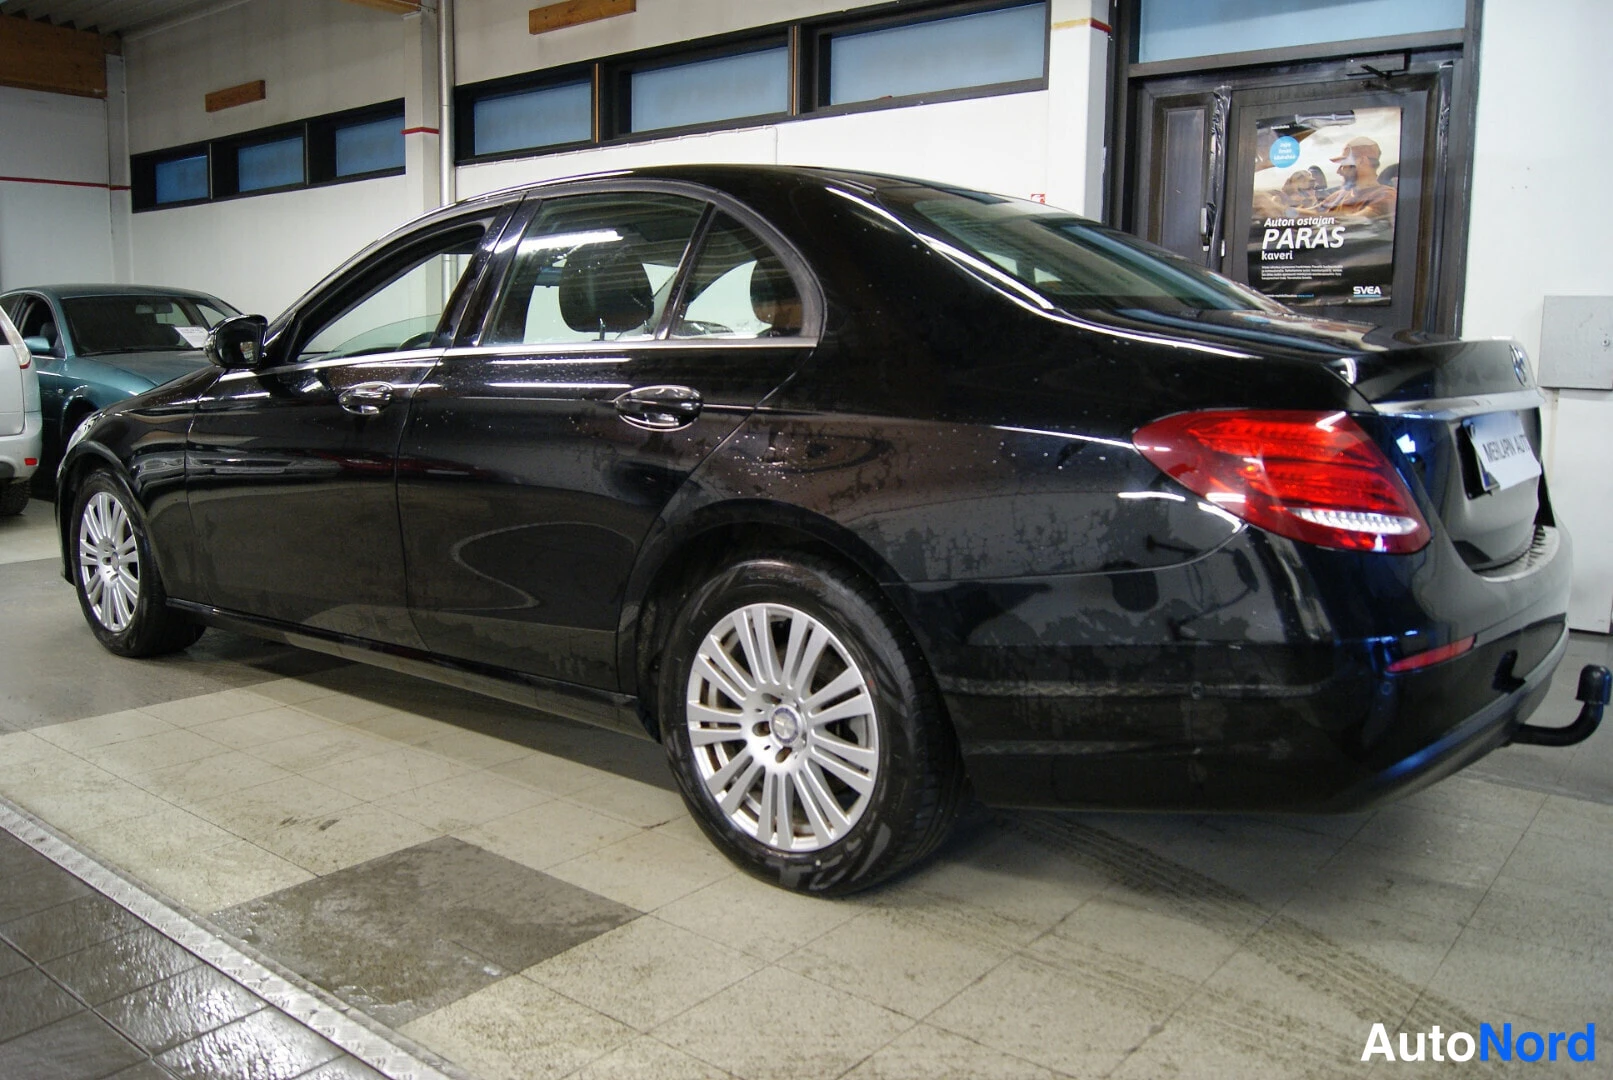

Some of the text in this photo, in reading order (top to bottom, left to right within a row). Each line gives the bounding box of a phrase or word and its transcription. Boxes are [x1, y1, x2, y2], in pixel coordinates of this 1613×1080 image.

[1264, 216, 1335, 227] Auton ostajan
[1262, 226, 1346, 250] PARAS
[1261, 250, 1293, 260] kaveri
[1353, 286, 1382, 295] SVEA
